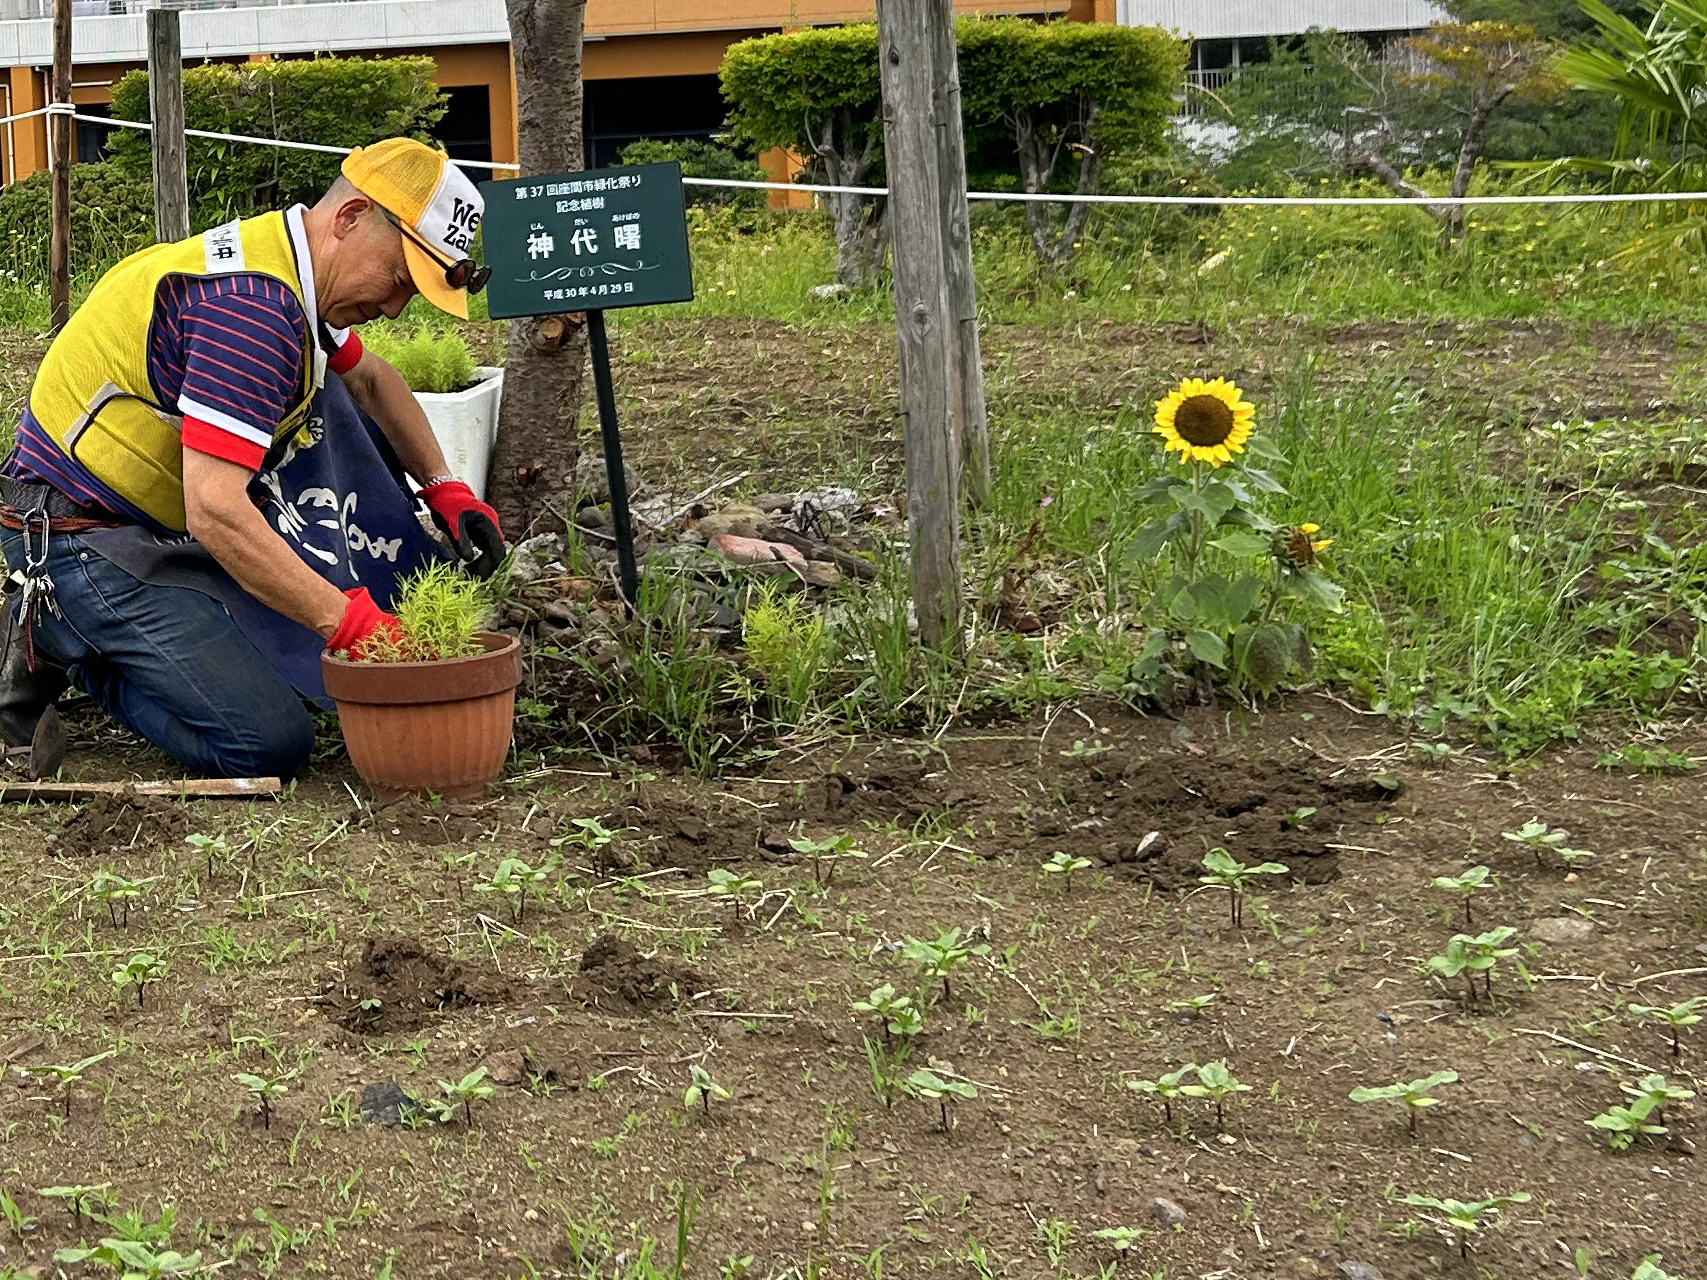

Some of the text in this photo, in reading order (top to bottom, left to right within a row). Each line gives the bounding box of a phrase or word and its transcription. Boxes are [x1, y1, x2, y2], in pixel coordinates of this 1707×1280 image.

[453, 197, 480, 232] We
[556, 196, 605, 214] 記念植樹
